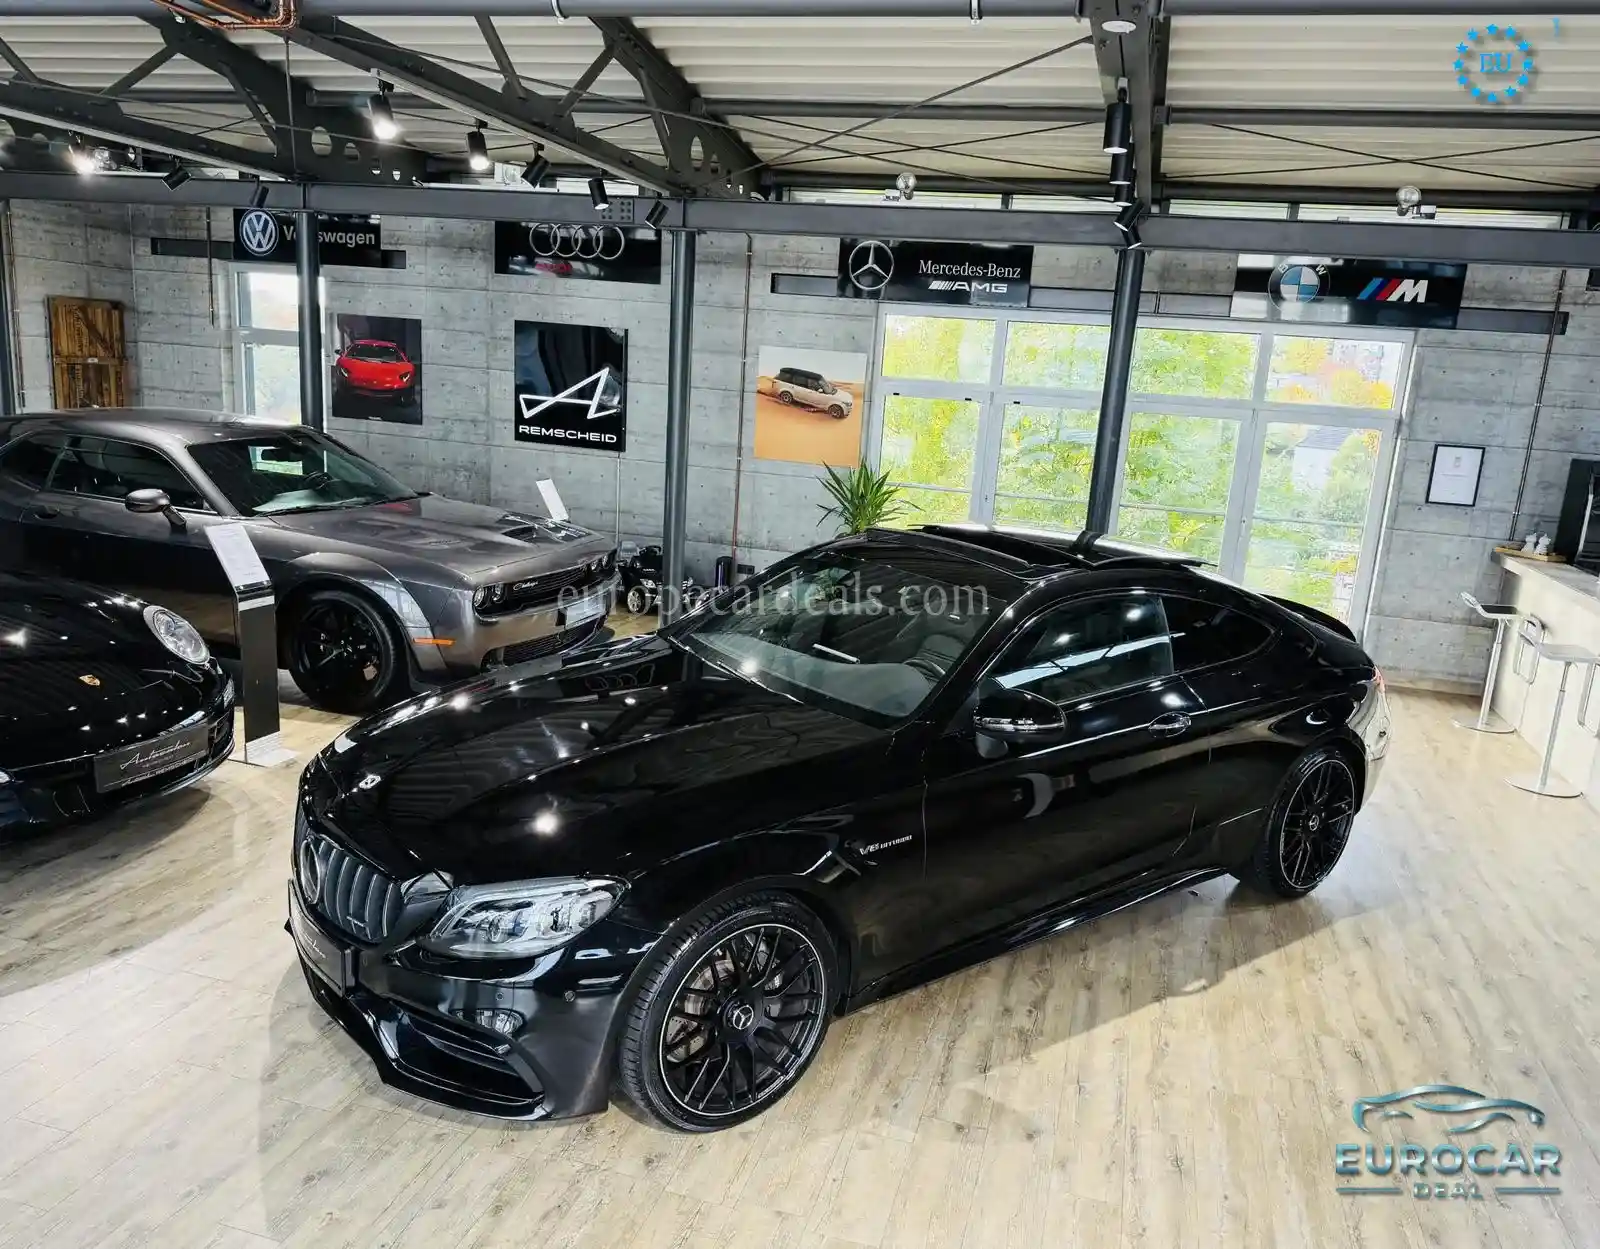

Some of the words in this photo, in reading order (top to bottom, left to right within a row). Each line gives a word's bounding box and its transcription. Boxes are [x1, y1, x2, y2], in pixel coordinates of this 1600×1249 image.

[283, 225, 375, 248] Vswagen
[918, 259, 1021, 279] Mercedes-Benz
[951, 281, 1009, 294] AMG
[1386, 279, 1429, 303] M
[518, 424, 618, 444] REMSCHEID
